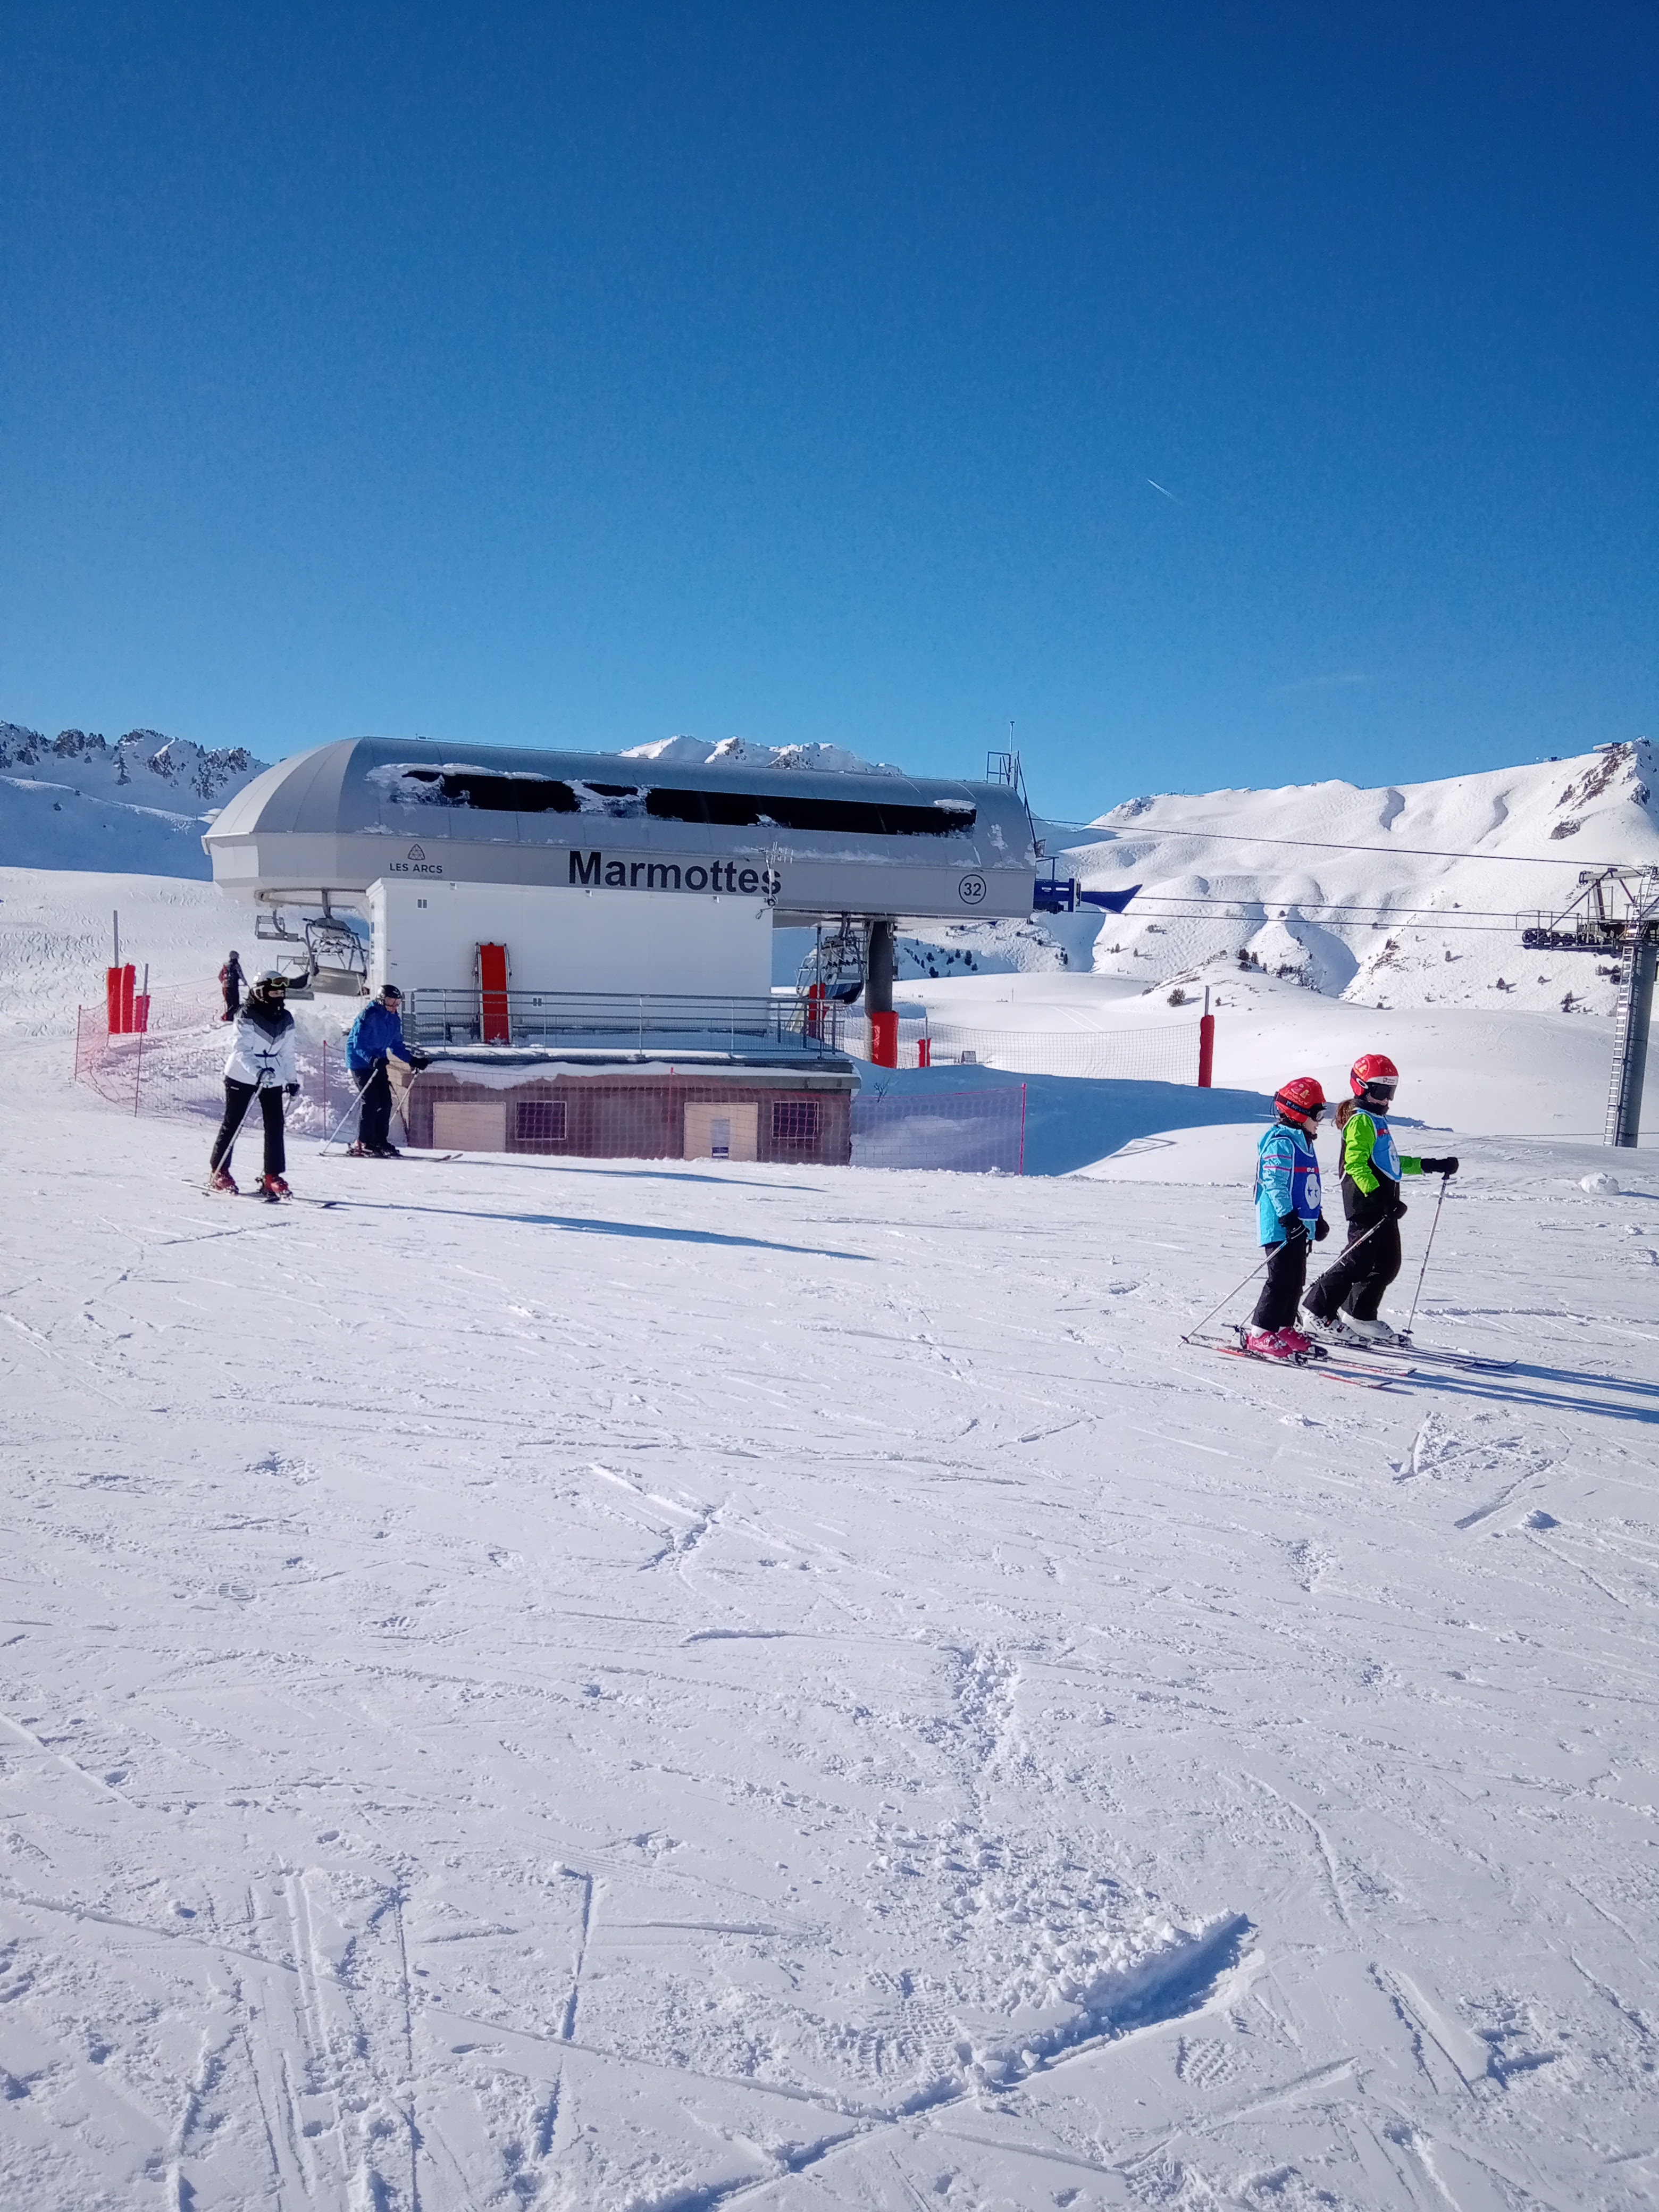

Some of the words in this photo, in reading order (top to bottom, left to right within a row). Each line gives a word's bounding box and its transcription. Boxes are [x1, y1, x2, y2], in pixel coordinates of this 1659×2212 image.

[390, 863, 409, 872] LES
[413, 864, 443, 874] ARCS
[569, 850, 782, 894] Marmottes
[963, 882, 982, 896] 32
